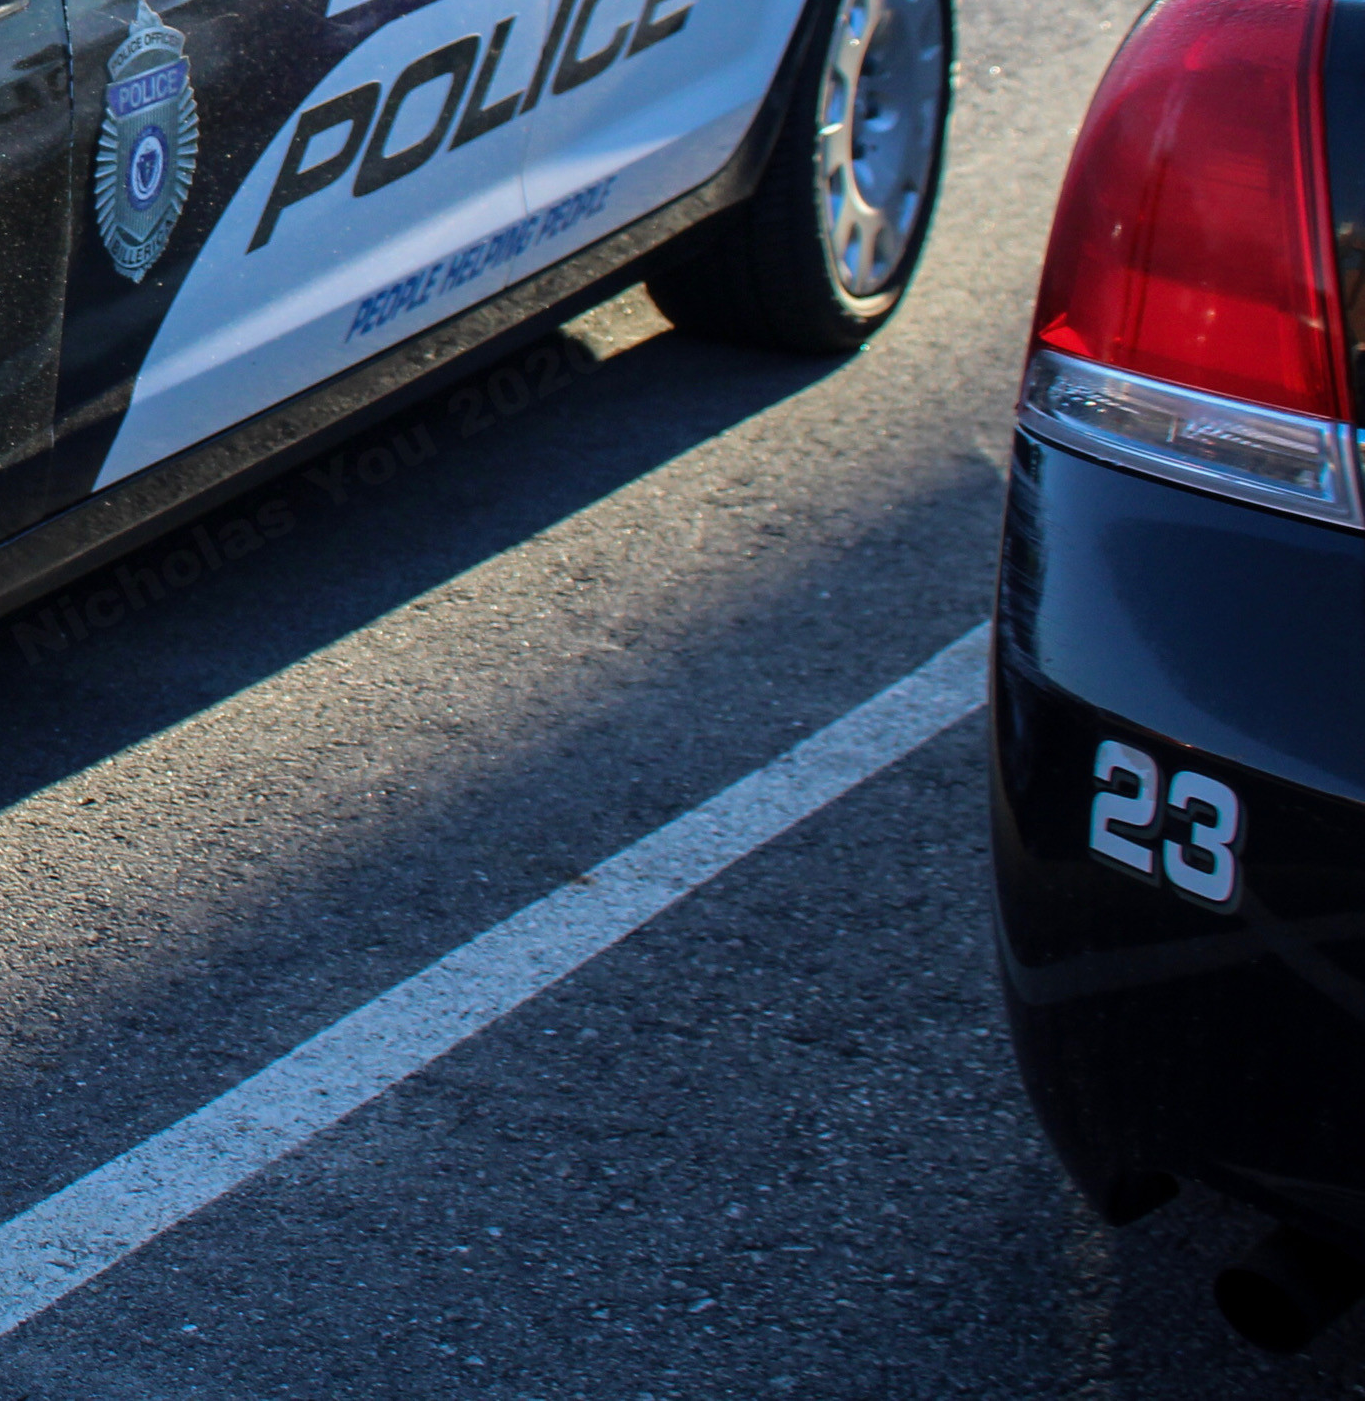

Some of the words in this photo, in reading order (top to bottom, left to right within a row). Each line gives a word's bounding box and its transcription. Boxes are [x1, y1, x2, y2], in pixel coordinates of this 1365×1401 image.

[119, 67, 179, 113] POLICE
[345, 263, 443, 344] PEOPLE
[533, 174, 617, 246] PEOPLE
[1089, 740, 1239, 901] 23
